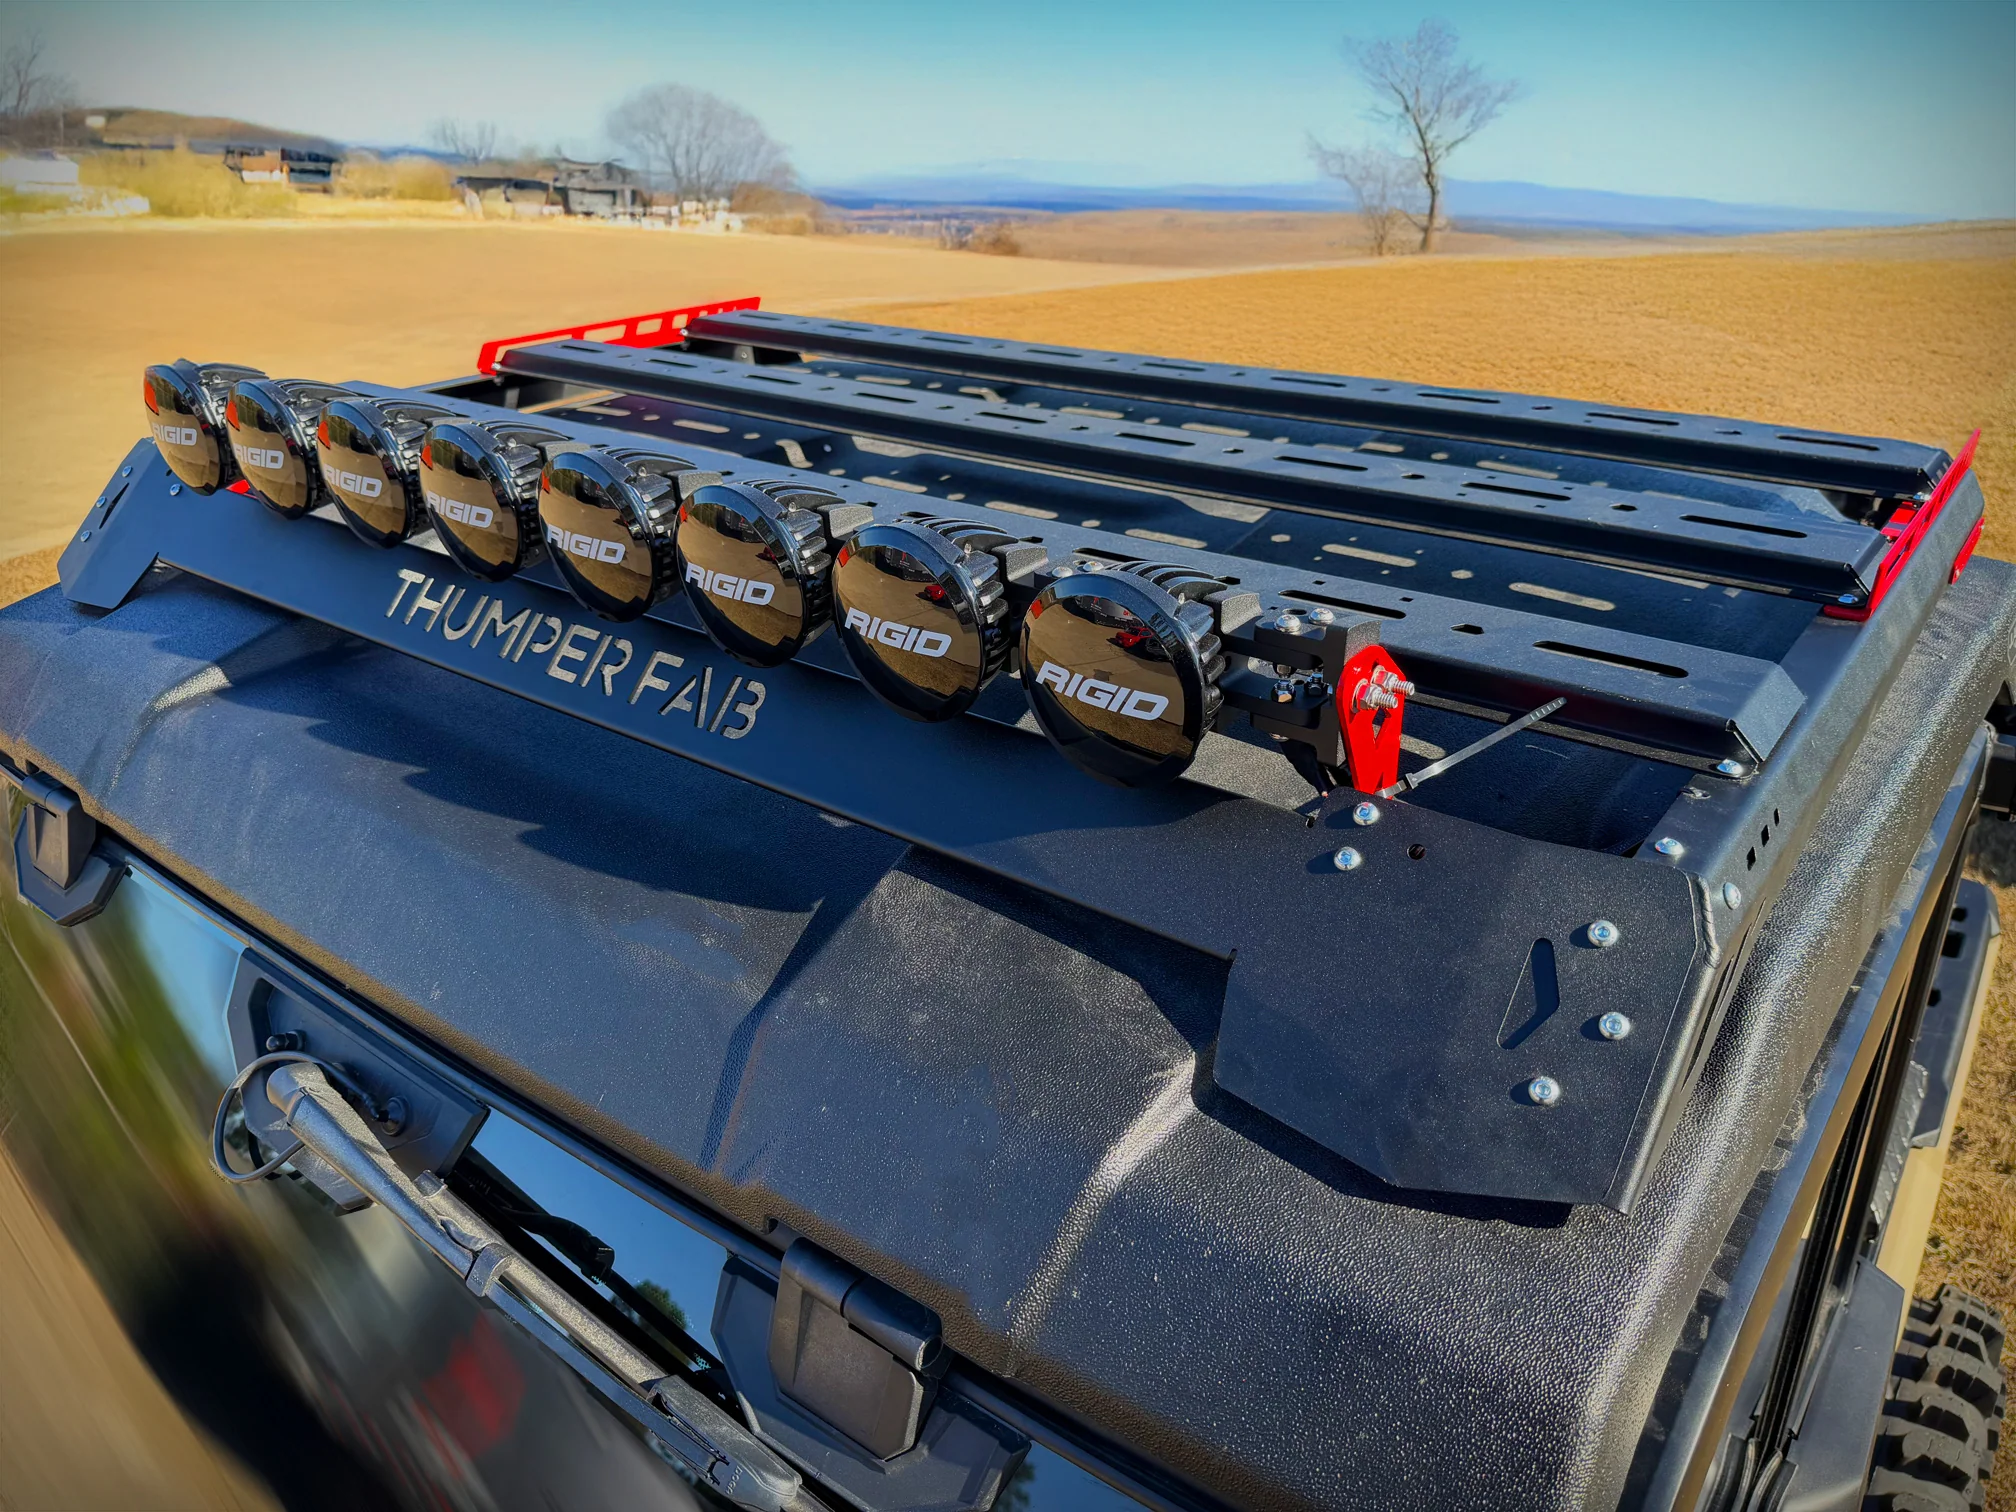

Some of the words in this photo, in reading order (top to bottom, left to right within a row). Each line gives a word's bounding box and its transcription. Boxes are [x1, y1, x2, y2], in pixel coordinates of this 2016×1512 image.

[153, 423, 198, 446] RIGID
[235, 446, 285, 470] RIGID
[325, 466, 383, 498] RIGID
[427, 491, 494, 528] RIGID
[547, 524, 626, 565] RIGID
[685, 562, 775, 606] RIGID
[844, 607, 952, 658] RIGID
[384, 568, 634, 697] THUMPER
[627, 649, 767, 740] FAB
[1035, 660, 1169, 721] RIGID
